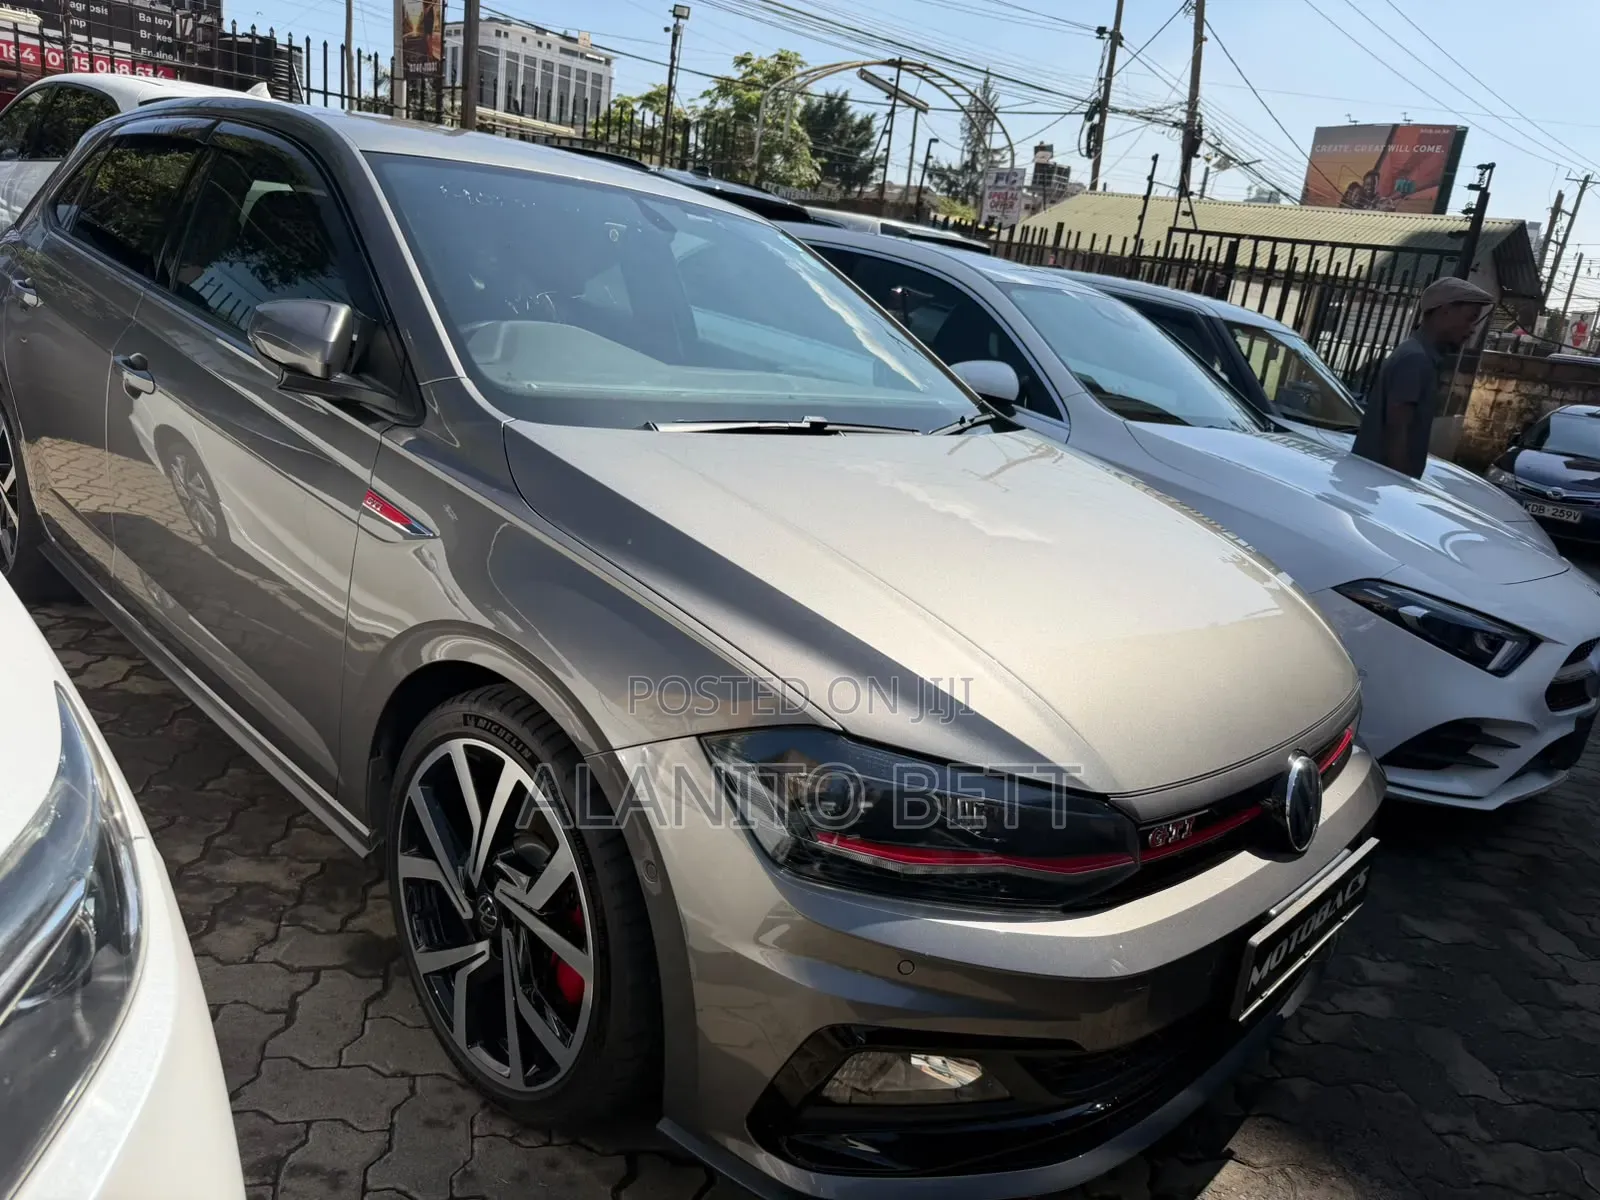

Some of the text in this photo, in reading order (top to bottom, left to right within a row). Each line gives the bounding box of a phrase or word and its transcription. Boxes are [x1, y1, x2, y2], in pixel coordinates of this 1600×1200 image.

[138, 12, 172, 28] Batery
[140, 29, 173, 43] Brkes
[1387, 144, 1410, 153] WILL
[1551, 507, 1580, 521] 259V
[476, 719, 532, 759] MICHELIN
[1148, 816, 1196, 848] GTI
